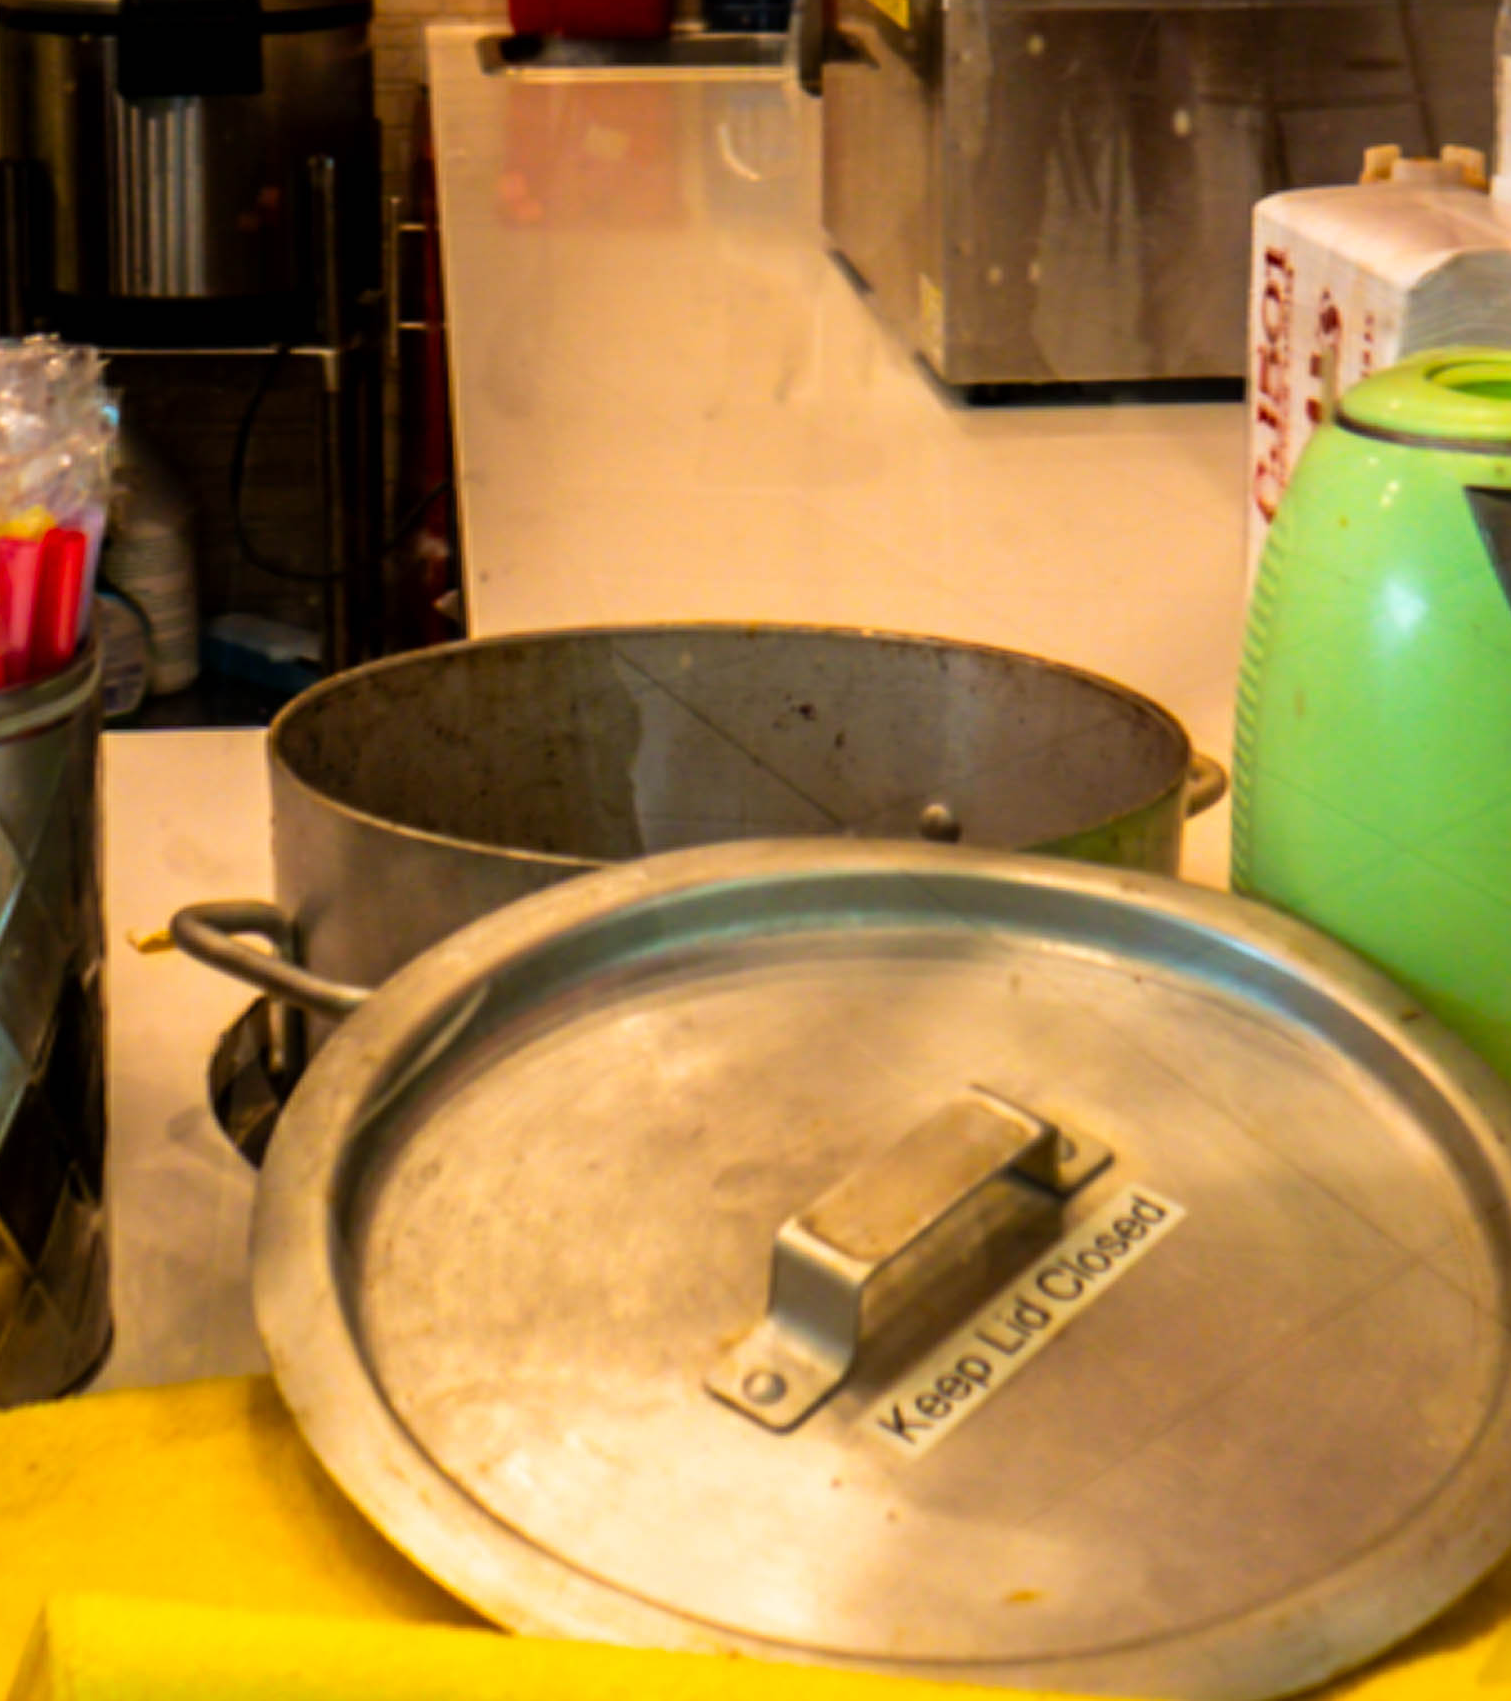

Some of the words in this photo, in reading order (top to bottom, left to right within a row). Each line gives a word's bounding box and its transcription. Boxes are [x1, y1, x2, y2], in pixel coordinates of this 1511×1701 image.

[877, 1354, 994, 1445] Keep
[975, 1299, 1050, 1359] Lid
[1034, 1194, 1168, 1304] Closed
